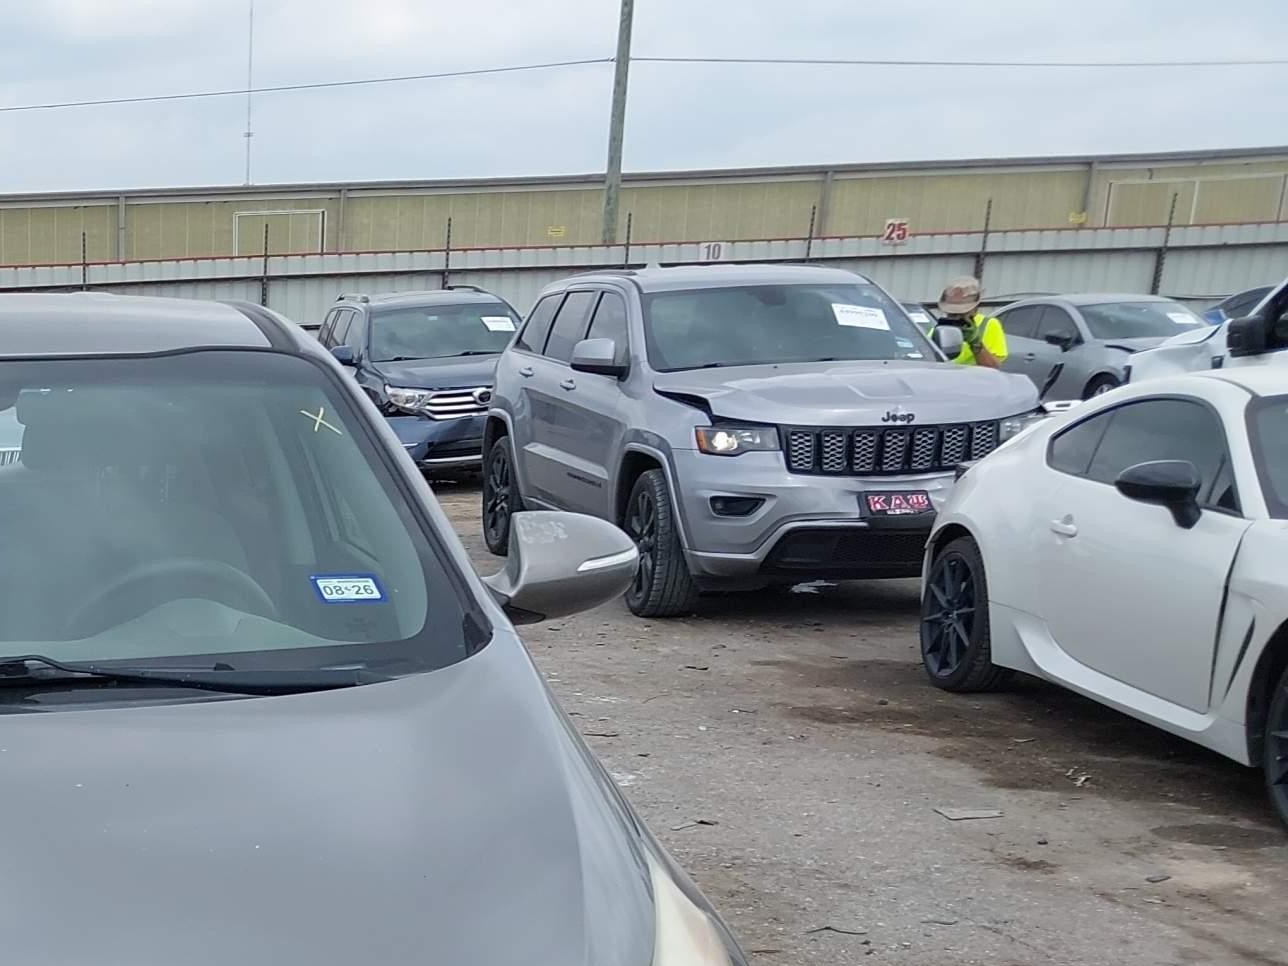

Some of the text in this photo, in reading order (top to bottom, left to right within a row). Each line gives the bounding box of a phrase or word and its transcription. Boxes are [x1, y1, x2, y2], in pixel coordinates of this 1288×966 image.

[885, 222, 907, 241] 25
[703, 243, 721, 260] 10
[881, 411, 915, 424] Jeep
